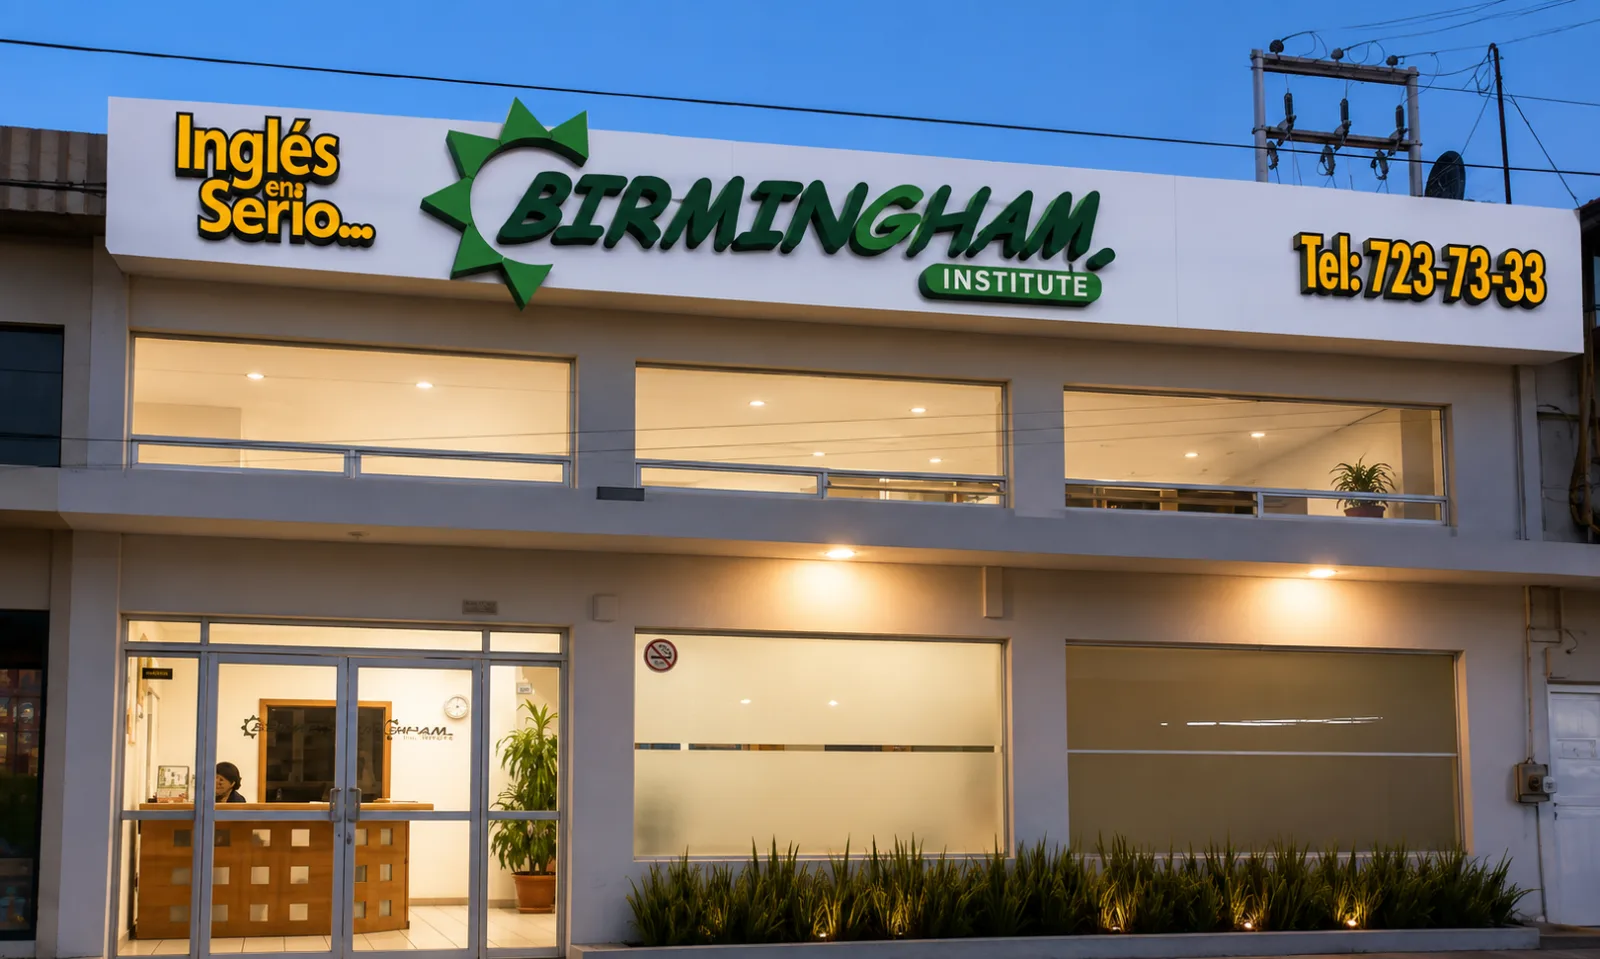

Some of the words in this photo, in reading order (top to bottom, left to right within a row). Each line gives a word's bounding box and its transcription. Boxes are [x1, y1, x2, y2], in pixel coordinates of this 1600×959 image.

[175, 111, 340, 190] Inglés
[198, 177, 376, 247] Serio...
[943, 268, 1088, 297] INSTITUTE
[1293, 231, 1362, 297] Tel:
[1362, 237, 1548, 308] 723-73-33
